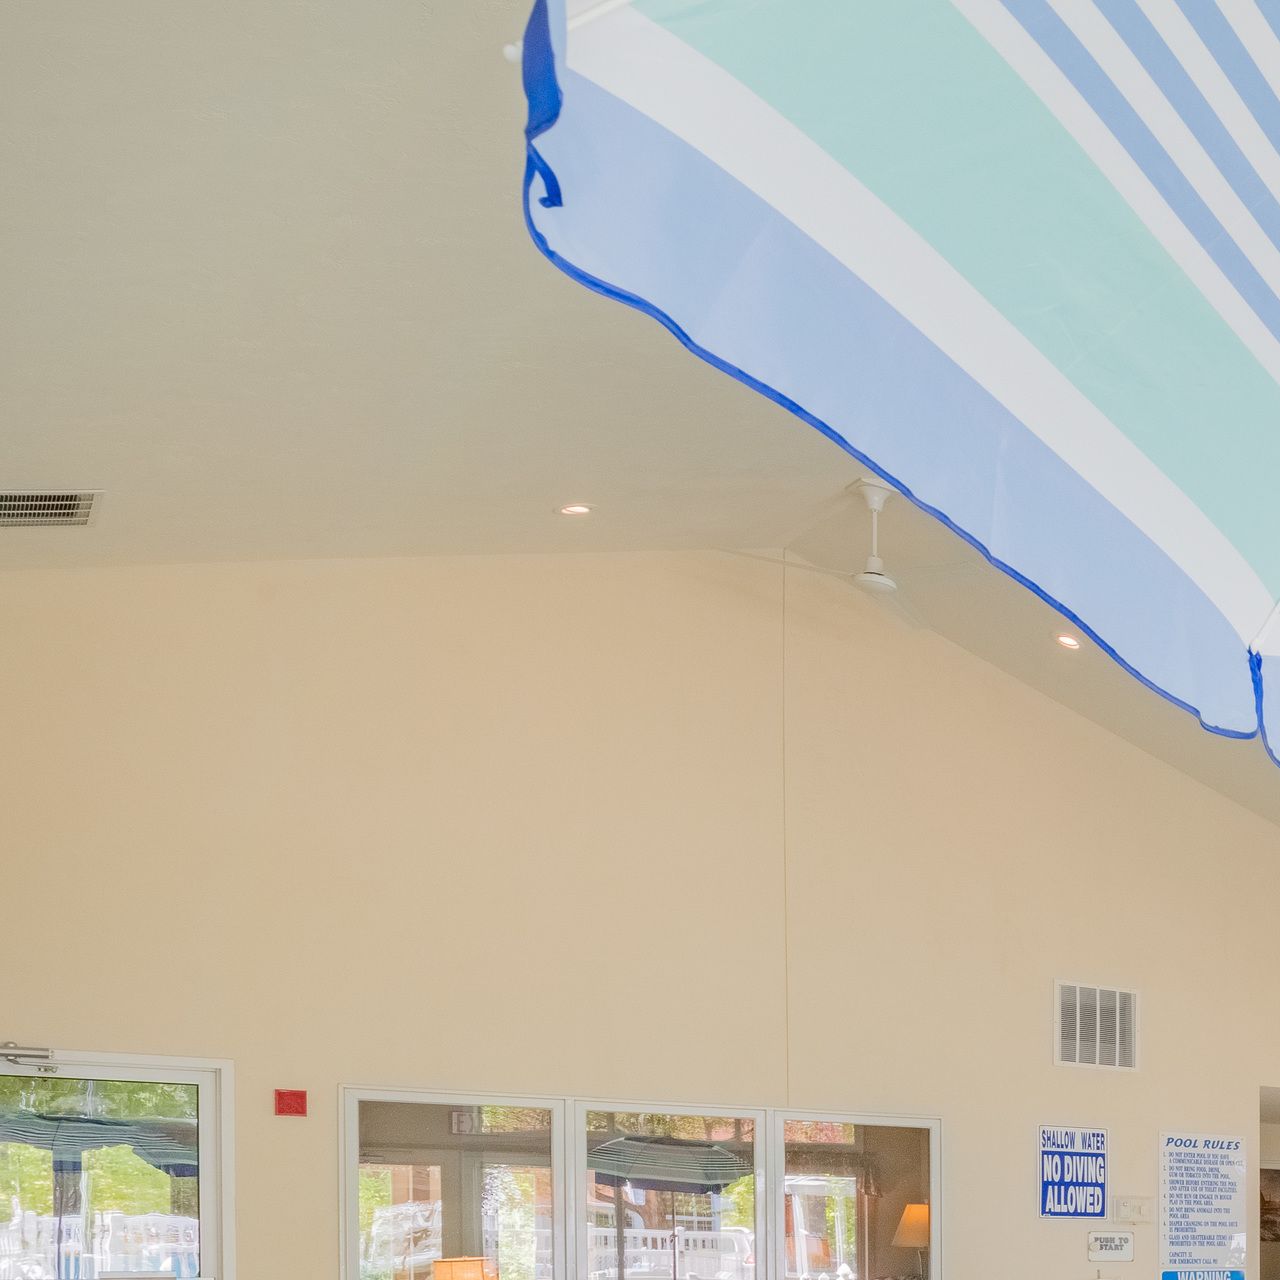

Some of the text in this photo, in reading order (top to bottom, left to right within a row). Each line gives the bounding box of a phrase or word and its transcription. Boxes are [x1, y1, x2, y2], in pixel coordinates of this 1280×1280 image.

[1041, 1129, 1105, 1150] SHALLOW WATER
[1165, 1137, 1241, 1150] POOL RULES
[1043, 1154, 1105, 1183] NO DIVING
[1045, 1185, 1102, 1213] ALLOWED
